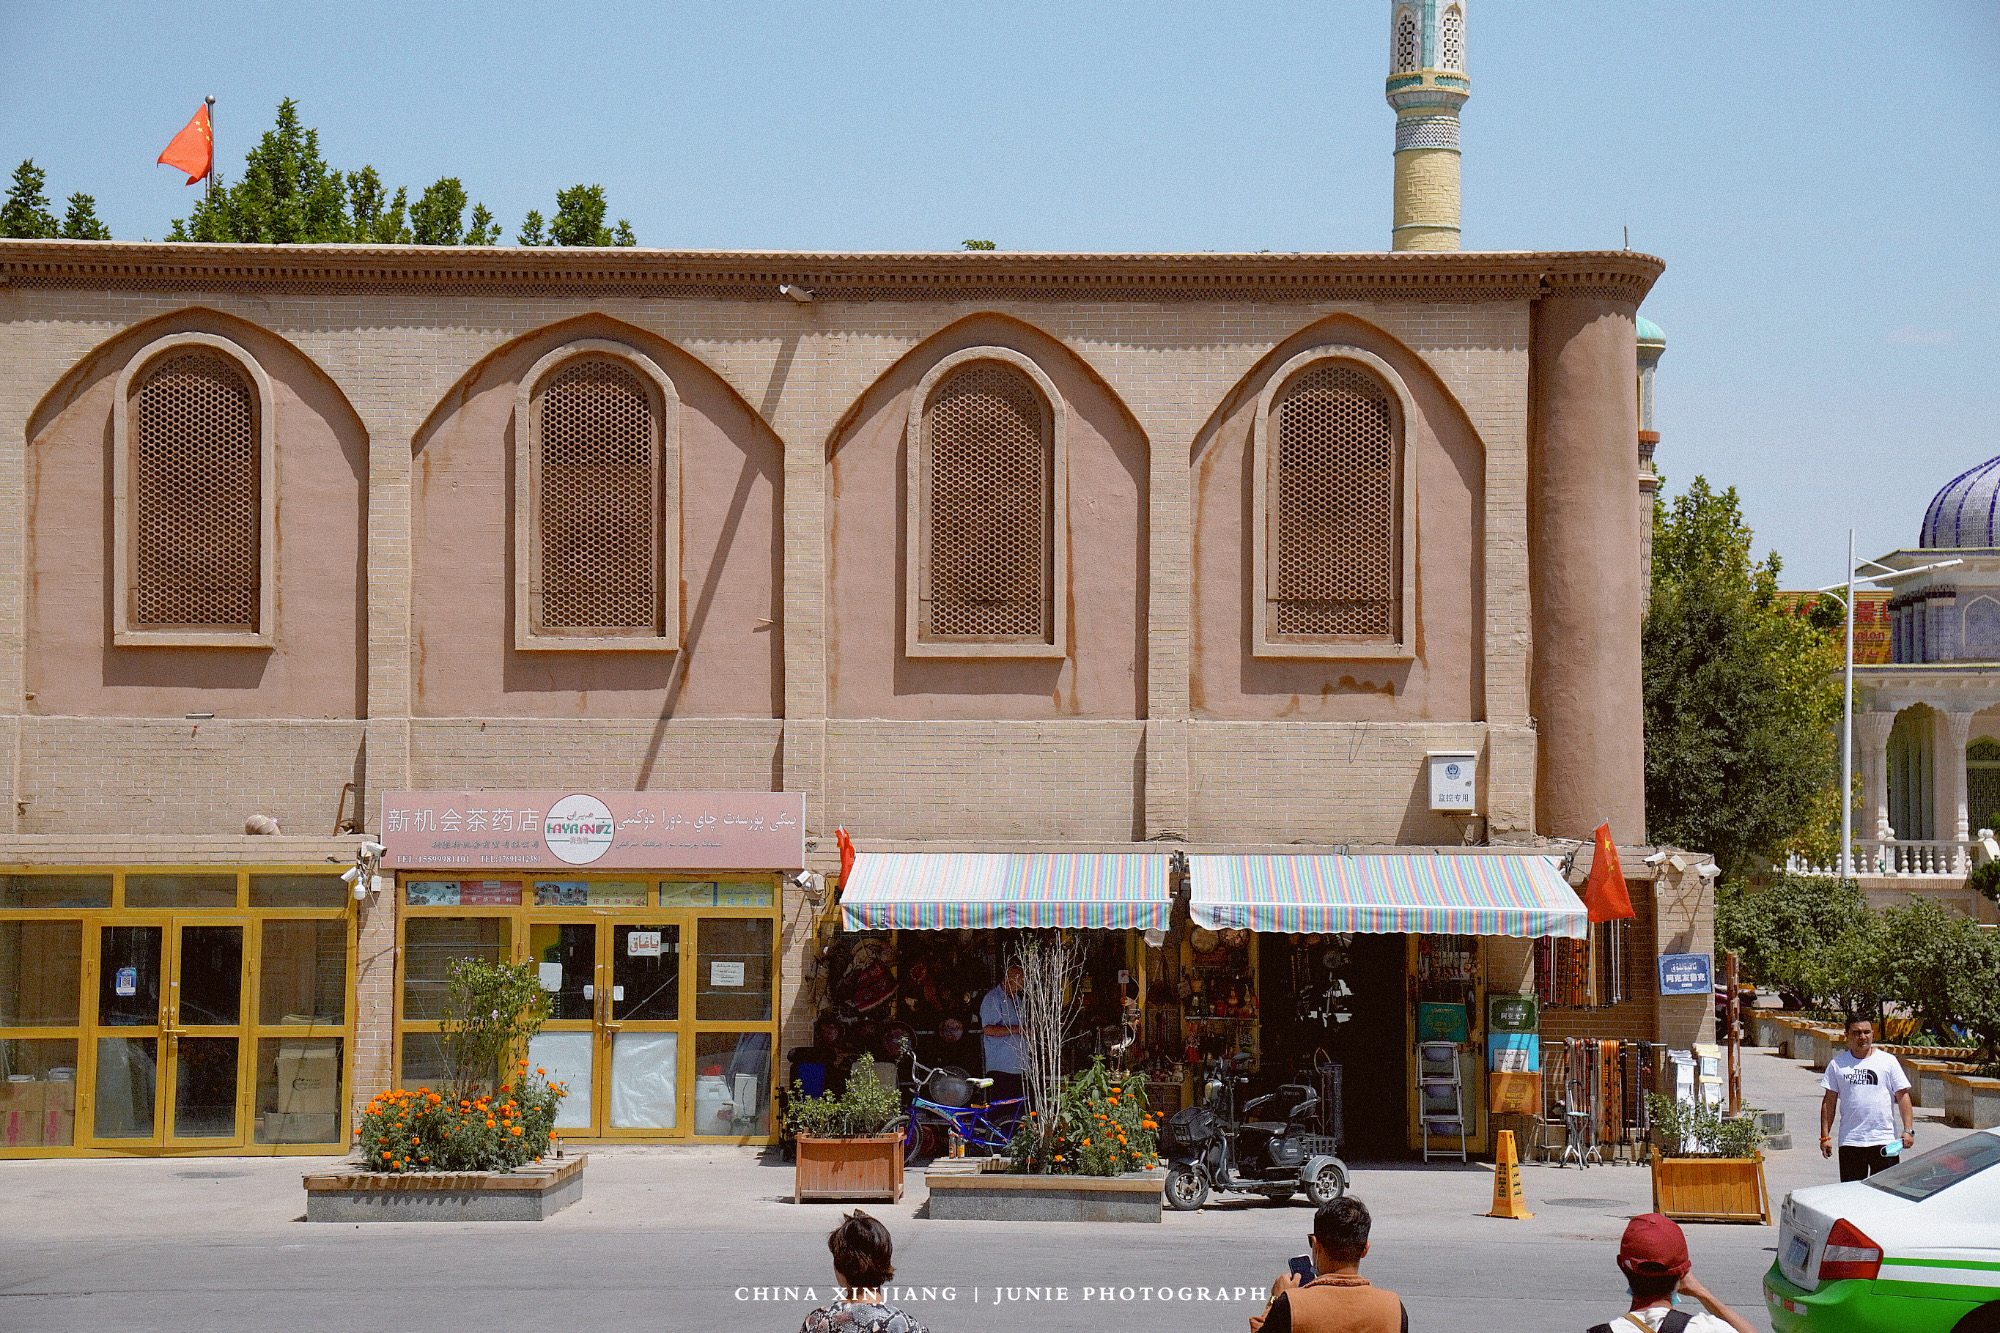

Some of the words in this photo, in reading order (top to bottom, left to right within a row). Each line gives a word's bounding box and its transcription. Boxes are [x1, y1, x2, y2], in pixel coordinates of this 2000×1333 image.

[1438, 793, 1469, 802] 监控专用
[387, 808, 540, 832] 新机会茶药店
